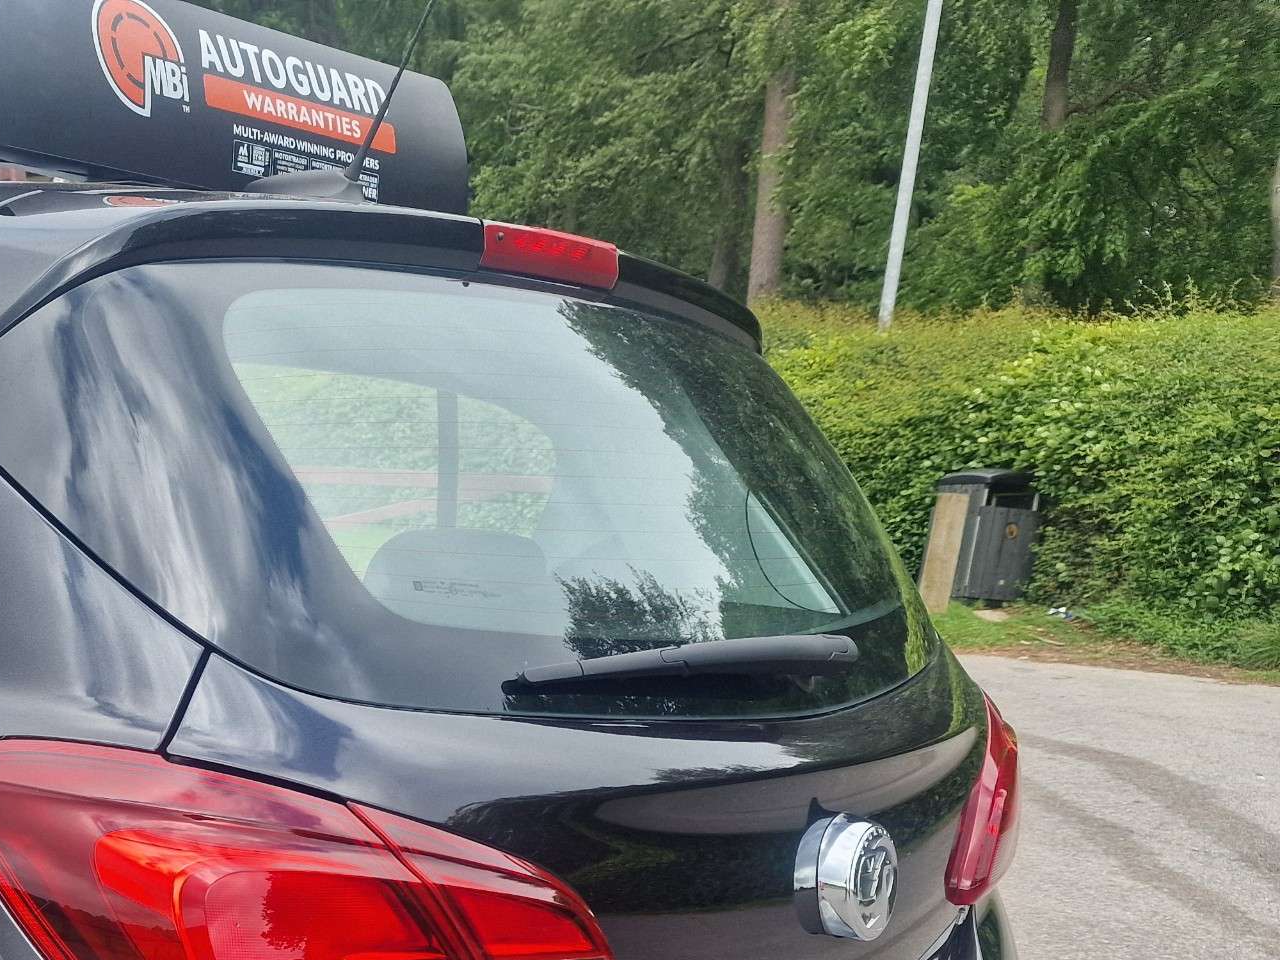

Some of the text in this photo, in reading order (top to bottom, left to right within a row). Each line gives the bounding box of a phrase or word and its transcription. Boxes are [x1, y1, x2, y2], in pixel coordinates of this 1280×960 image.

[144, 55, 190, 103] MBi
[198, 29, 389, 116] AUTOGUARD
[243, 89, 361, 138] WARRANTIES
[233, 123, 296, 150] MULTI-AWARD
[296, 139, 335, 159] WINNING
